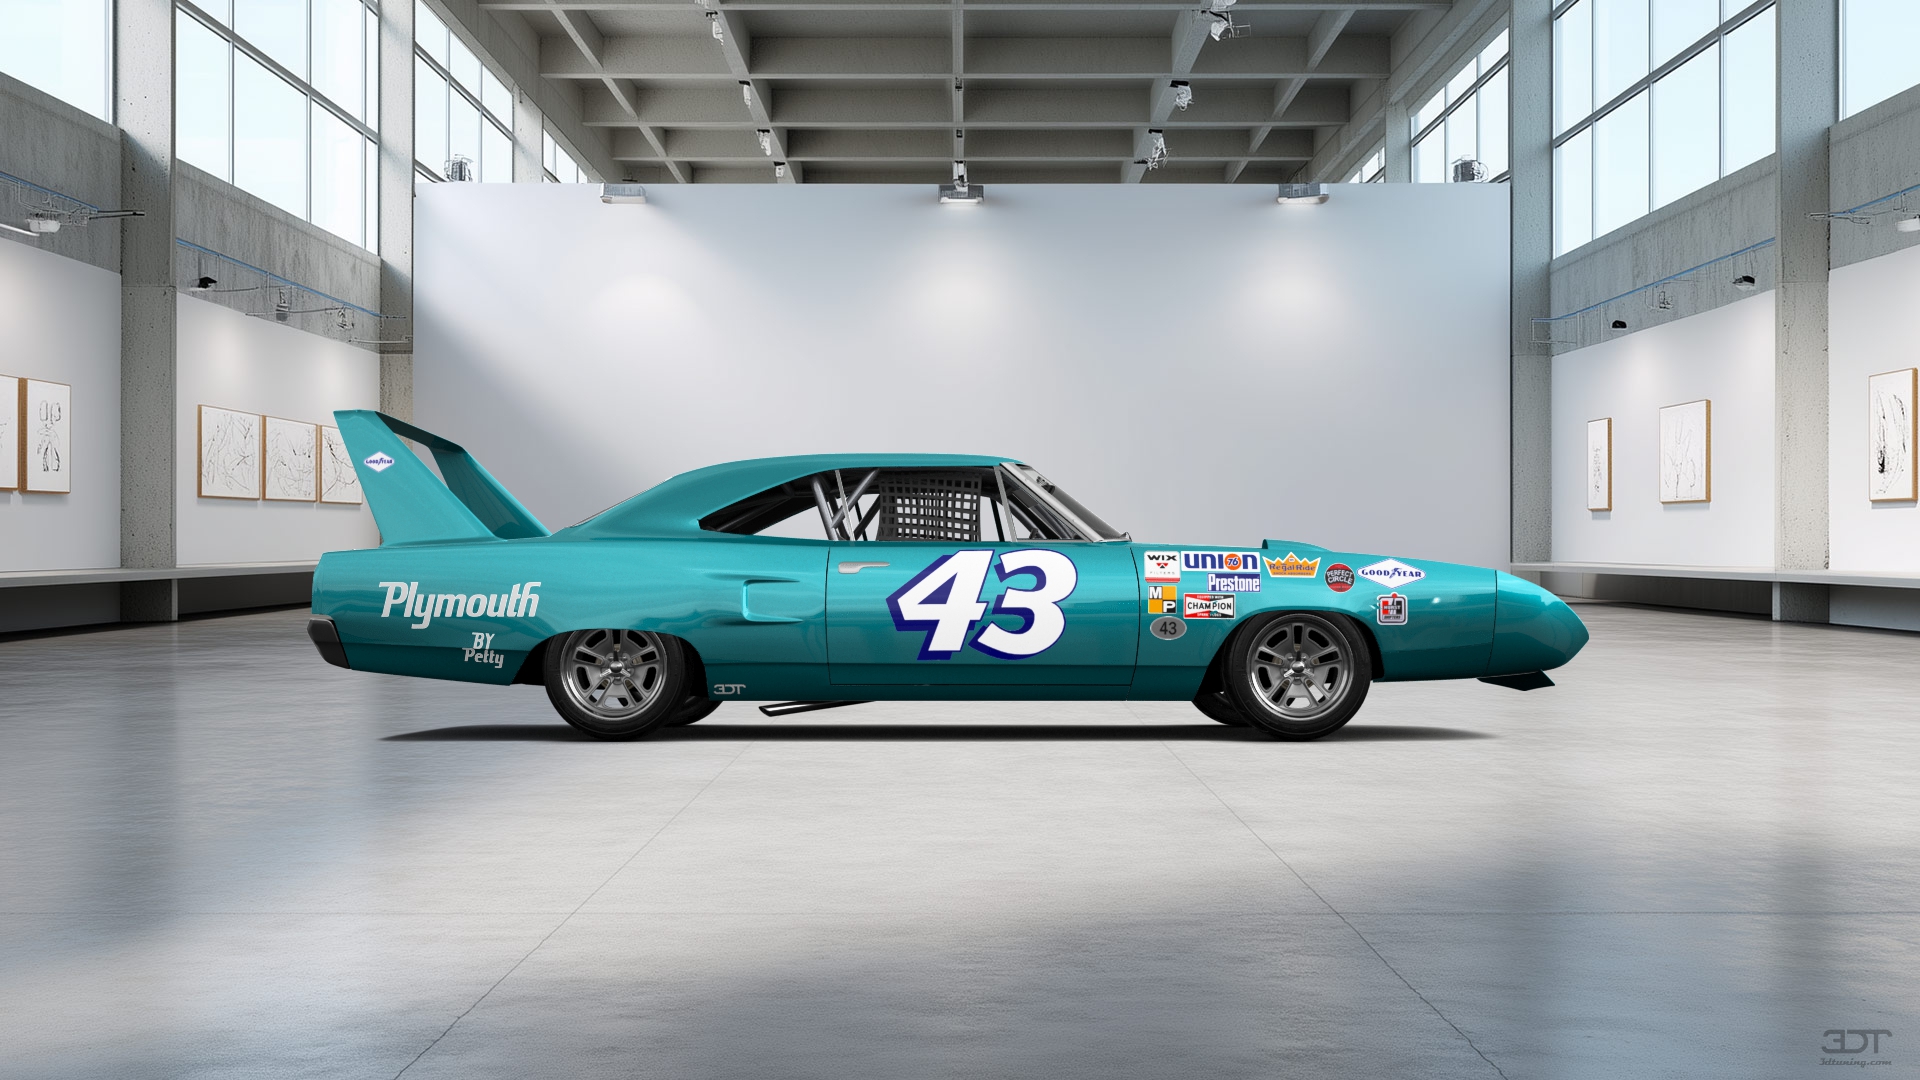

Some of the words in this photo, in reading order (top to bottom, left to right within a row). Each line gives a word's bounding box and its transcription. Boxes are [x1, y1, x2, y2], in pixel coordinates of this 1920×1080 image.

[1227, 557, 1238, 566] 76
[1326, 569, 1353, 578] PERFECT
[1327, 575, 1353, 584] CIRCLE
[1207, 573, 1260, 591] Prestone
[378, 581, 542, 630] Plymouth
[884, 549, 1078, 660] 43
[1187, 602, 1232, 610] CHAMPION
[1159, 621, 1177, 635] 43
[471, 632, 496, 650] BY
[461, 647, 505, 669] Petty
